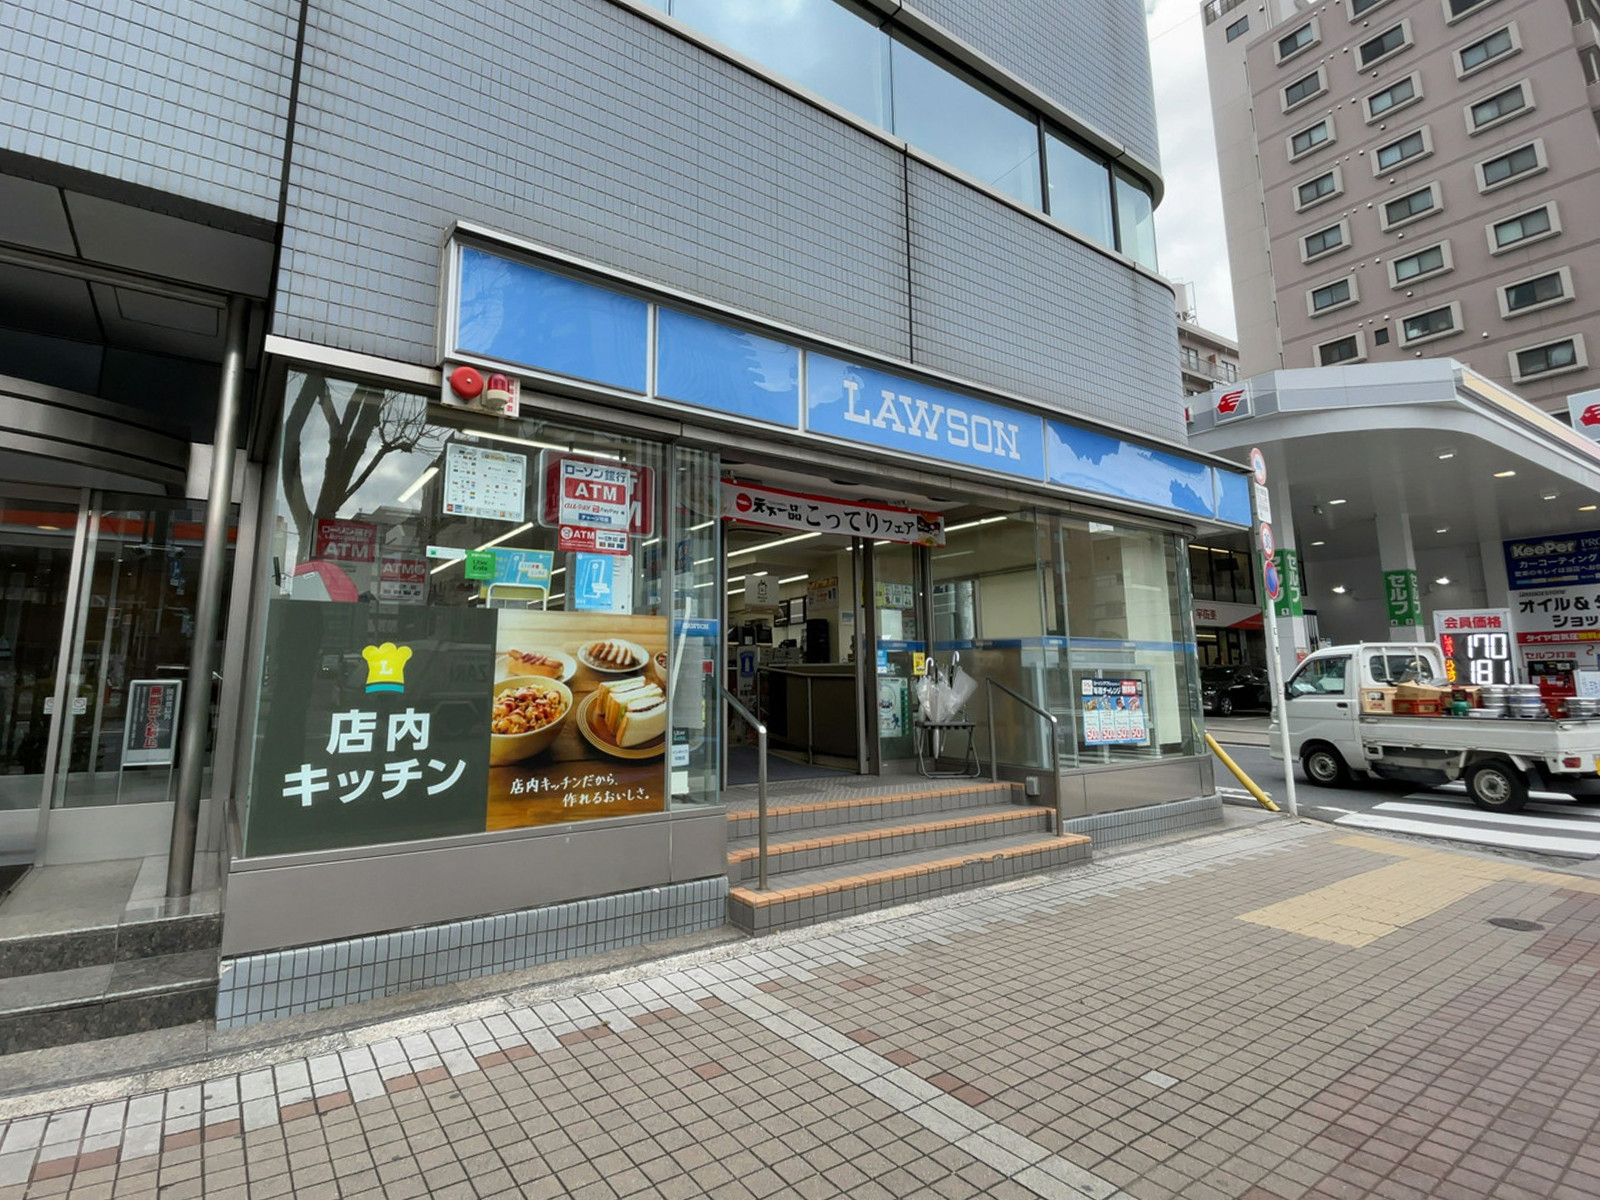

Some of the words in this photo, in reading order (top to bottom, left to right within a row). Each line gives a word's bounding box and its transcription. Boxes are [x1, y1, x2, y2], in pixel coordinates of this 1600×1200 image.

[843, 379, 1021, 460] LAWSON
[565, 464, 627, 483] ローソン銀行
[575, 482, 617, 502] ATM
[806, 504, 915, 535] こってりフェア
[573, 530, 595, 539] ATM
[324, 542, 369, 558] ATM
[1512, 541, 1575, 557] KeePer
[383, 563, 413, 575] ATM
[1519, 553, 1598, 569] カーコーティング
[1287, 554, 1301, 602] セルフ
[1387, 575, 1409, 615] セルフ
[1444, 616, 1502, 629] 会員価格
[1467, 633, 1507, 659] 170
[1525, 651, 1577, 660] セルフ灯油
[378, 660, 393, 675] L
[1471, 660, 1510, 684] 181
[327, 708, 430, 754] 店内
[282, 759, 466, 807] キッチン
[562, 787, 650, 807] 作れるおいしさ。
